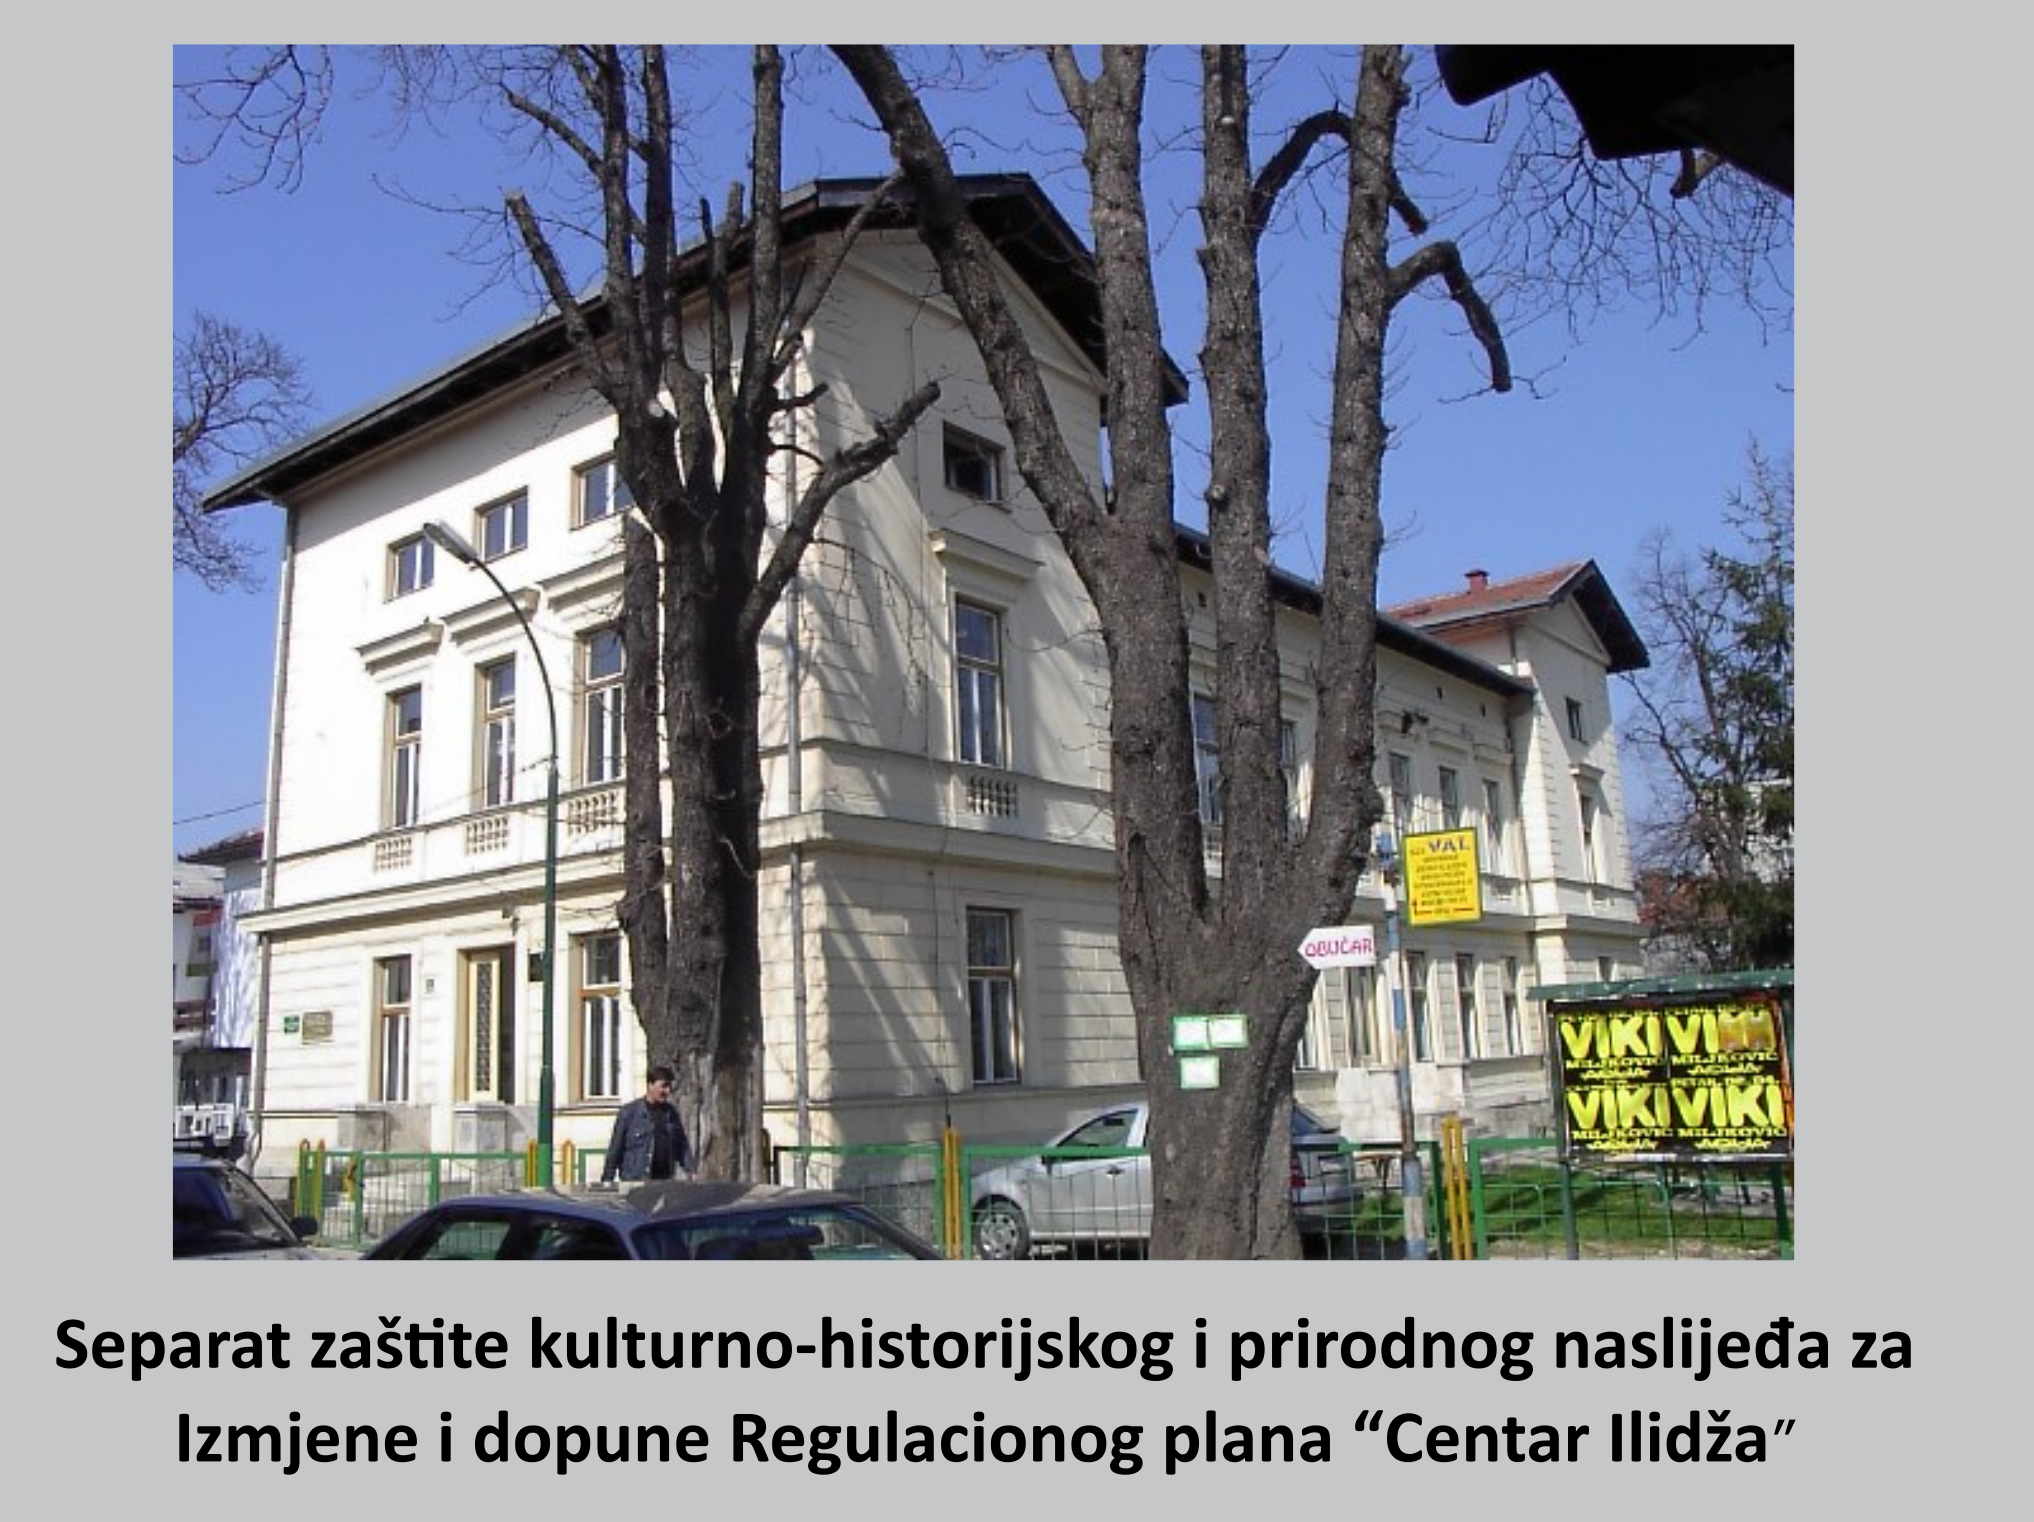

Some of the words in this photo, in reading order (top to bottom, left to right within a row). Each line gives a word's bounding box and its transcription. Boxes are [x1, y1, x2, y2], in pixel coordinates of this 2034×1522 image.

[1428, 837, 1470, 853] VAL
[1305, 937, 1373, 957] OBUČAR
[1560, 1015, 1663, 1059] VIKI
[1666, 1010, 1776, 1053] VI
[1567, 1087, 1671, 1129] VIKI
[1671, 1084, 1785, 1128] VIKI
